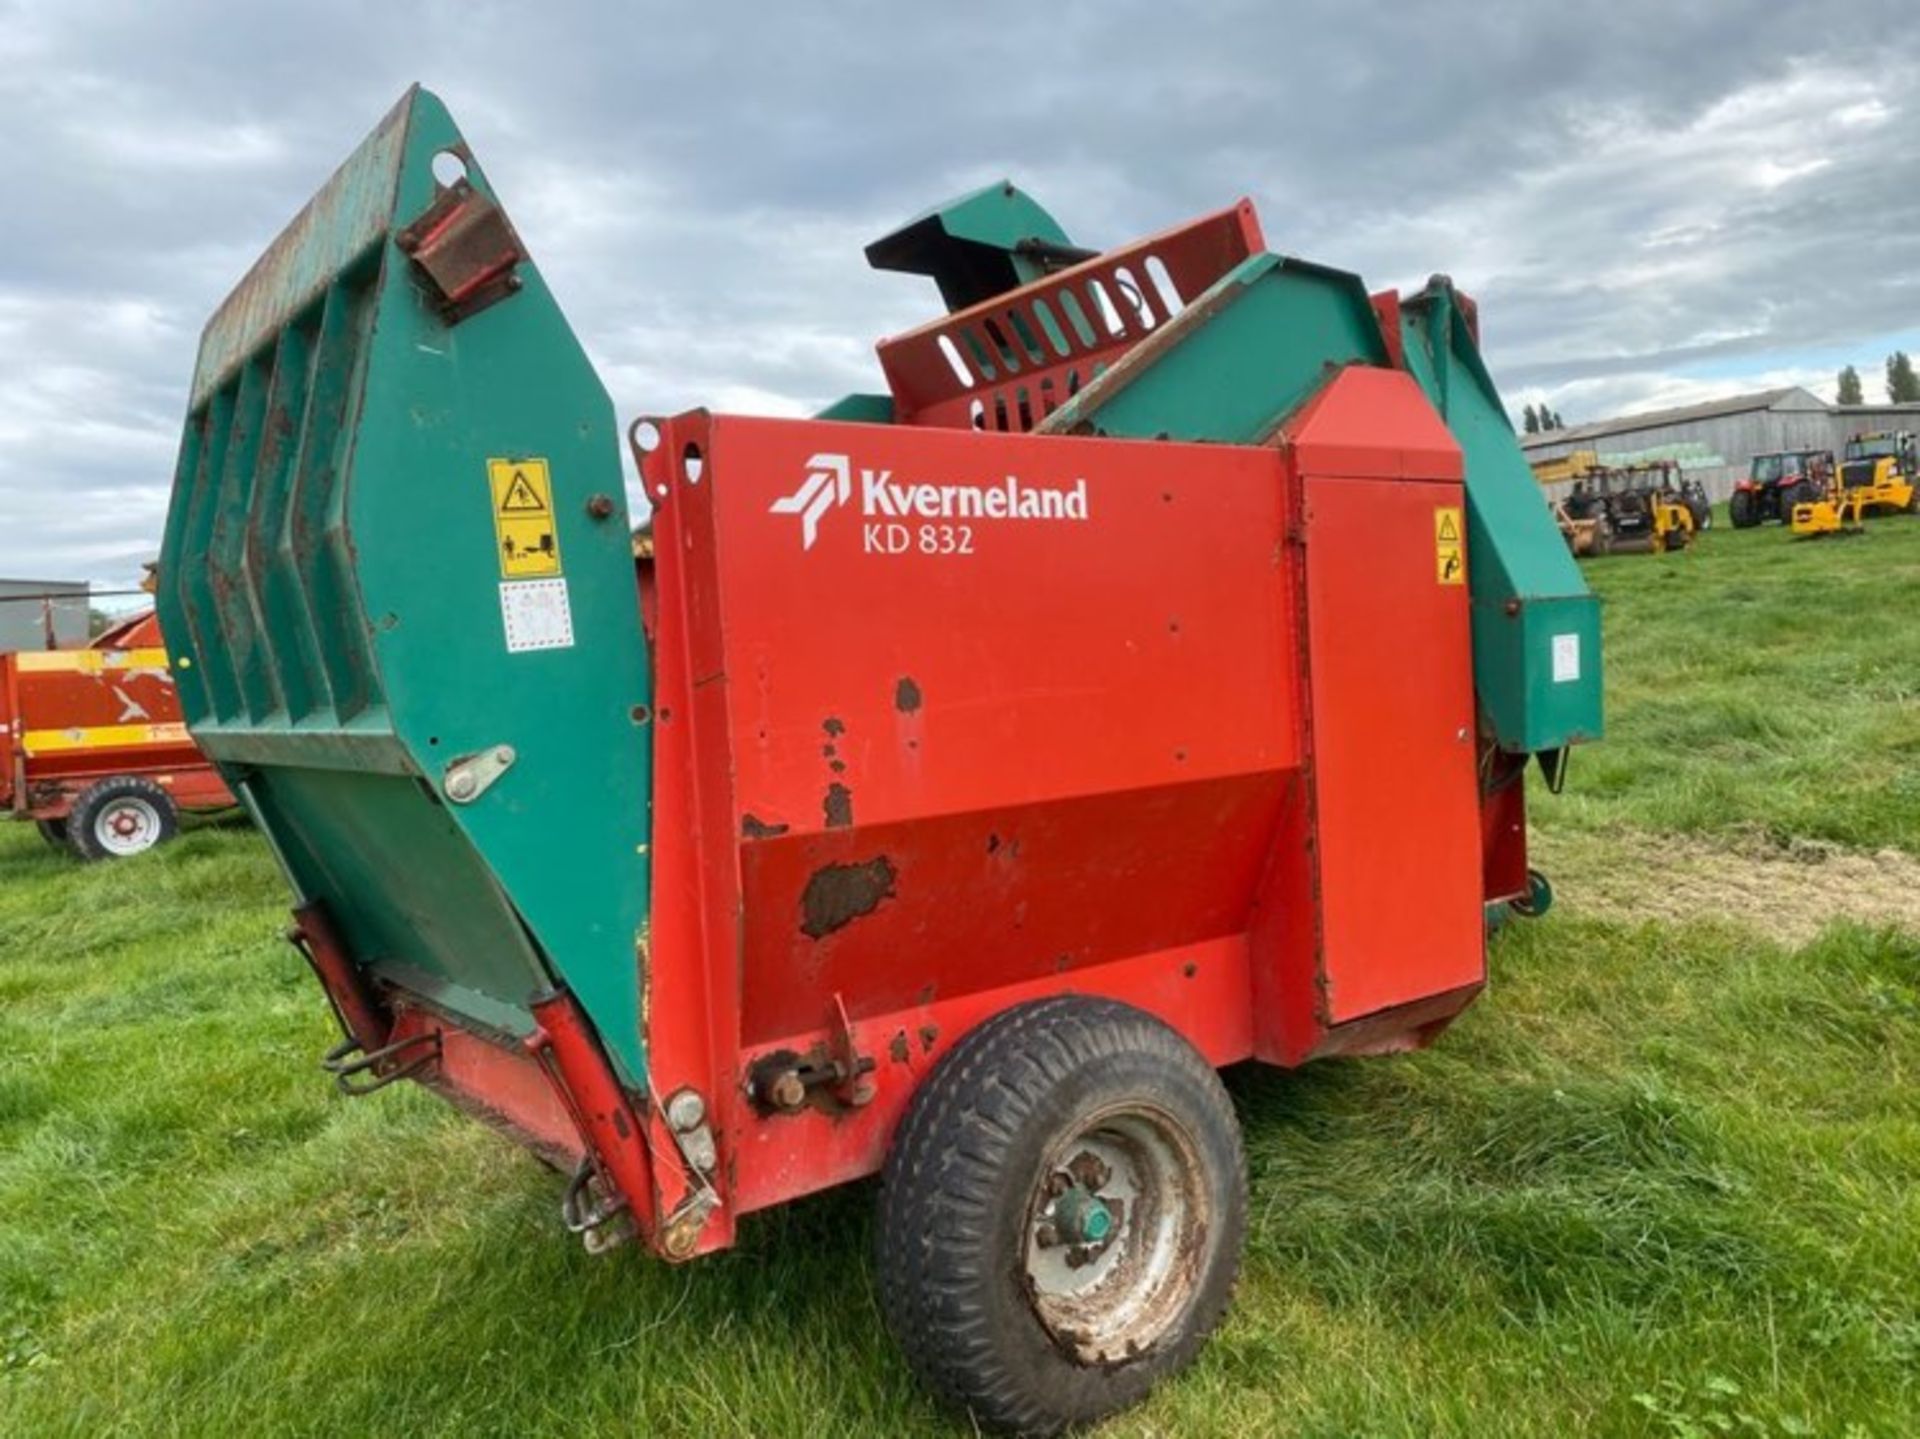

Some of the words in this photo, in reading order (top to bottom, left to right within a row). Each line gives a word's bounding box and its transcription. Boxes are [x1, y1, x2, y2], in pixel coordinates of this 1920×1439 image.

[861, 469, 1088, 519] Kverneland
[864, 524, 910, 553] KD
[919, 525, 974, 554] 832
